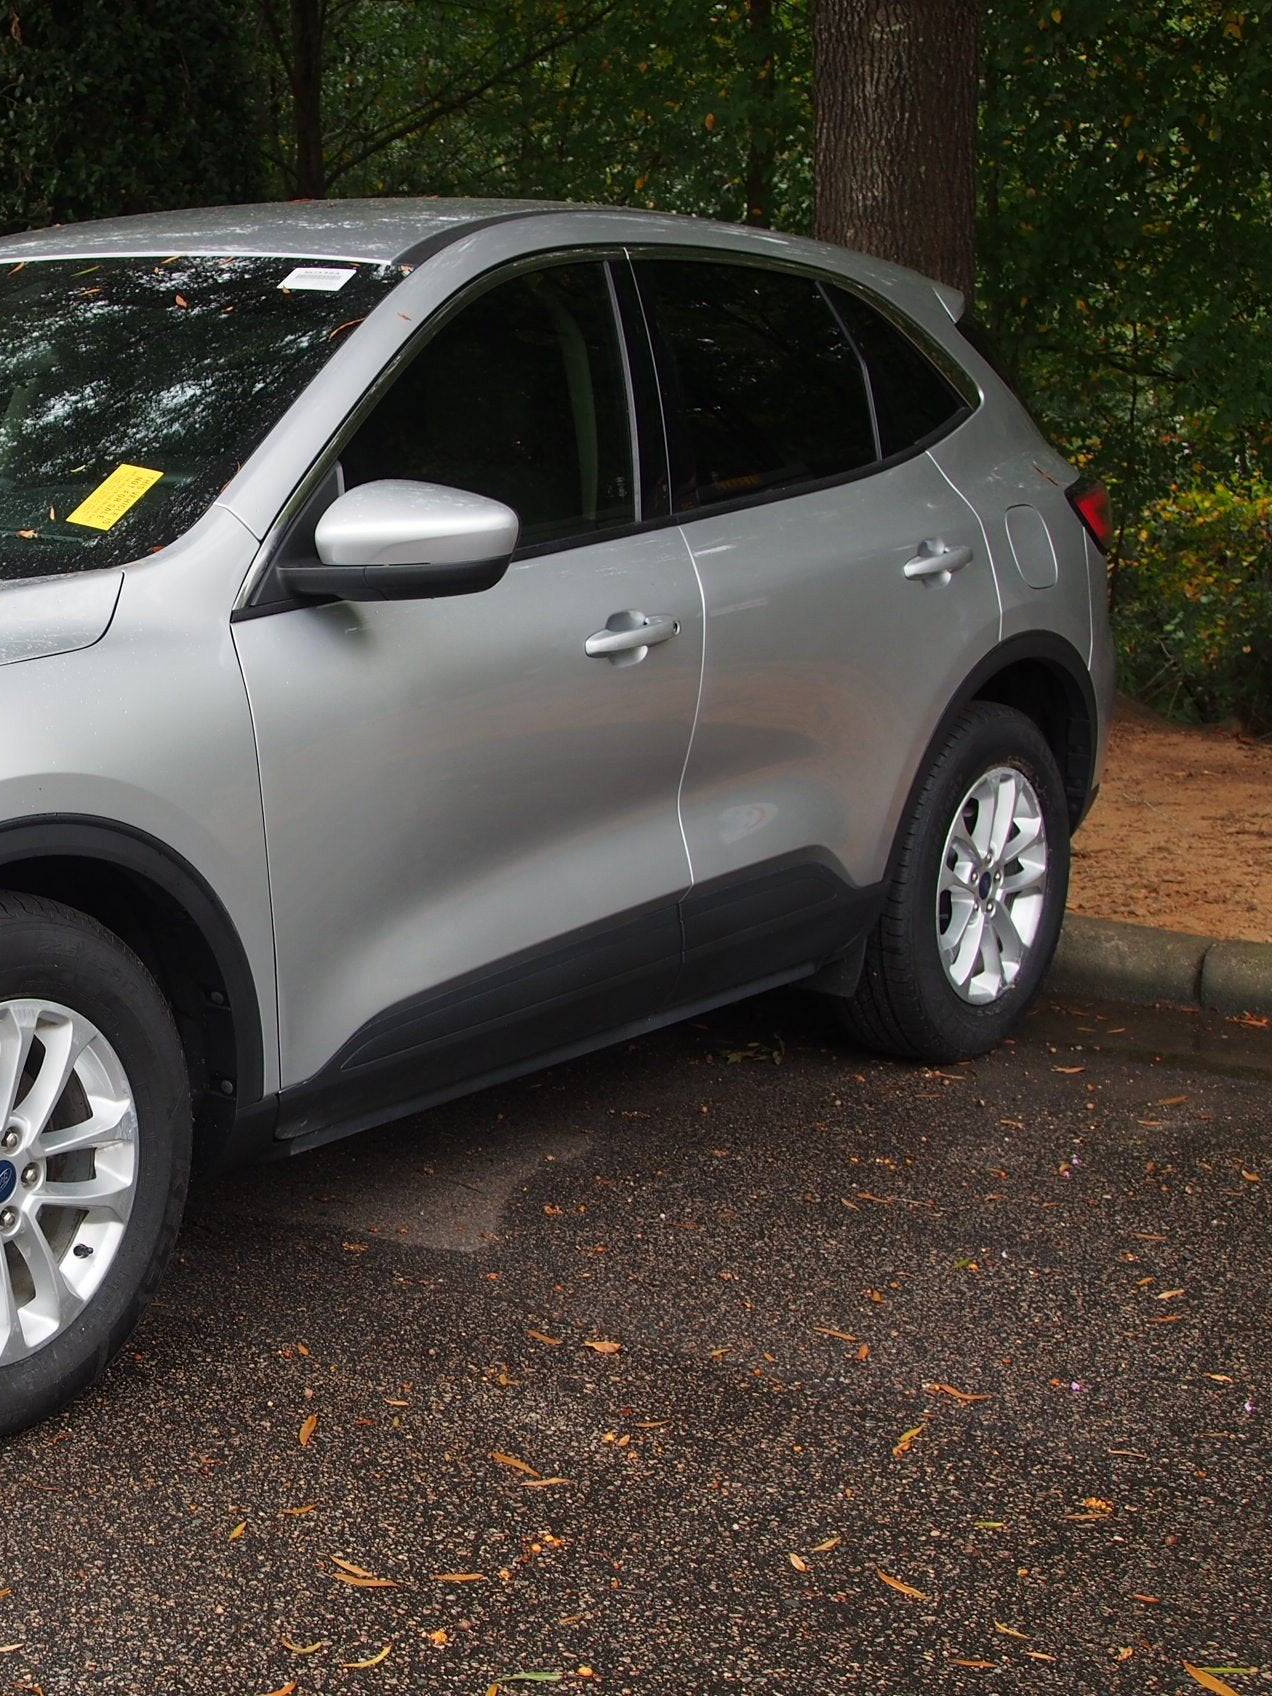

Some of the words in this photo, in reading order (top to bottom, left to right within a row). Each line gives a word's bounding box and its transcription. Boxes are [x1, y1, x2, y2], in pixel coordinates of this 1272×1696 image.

[126, 475, 144, 488] NOT
[136, 474, 156, 490] THIS
[109, 490, 139, 517] VEHICLE
[113, 490, 131, 502] FOR
[95, 503, 117, 520] SALE
